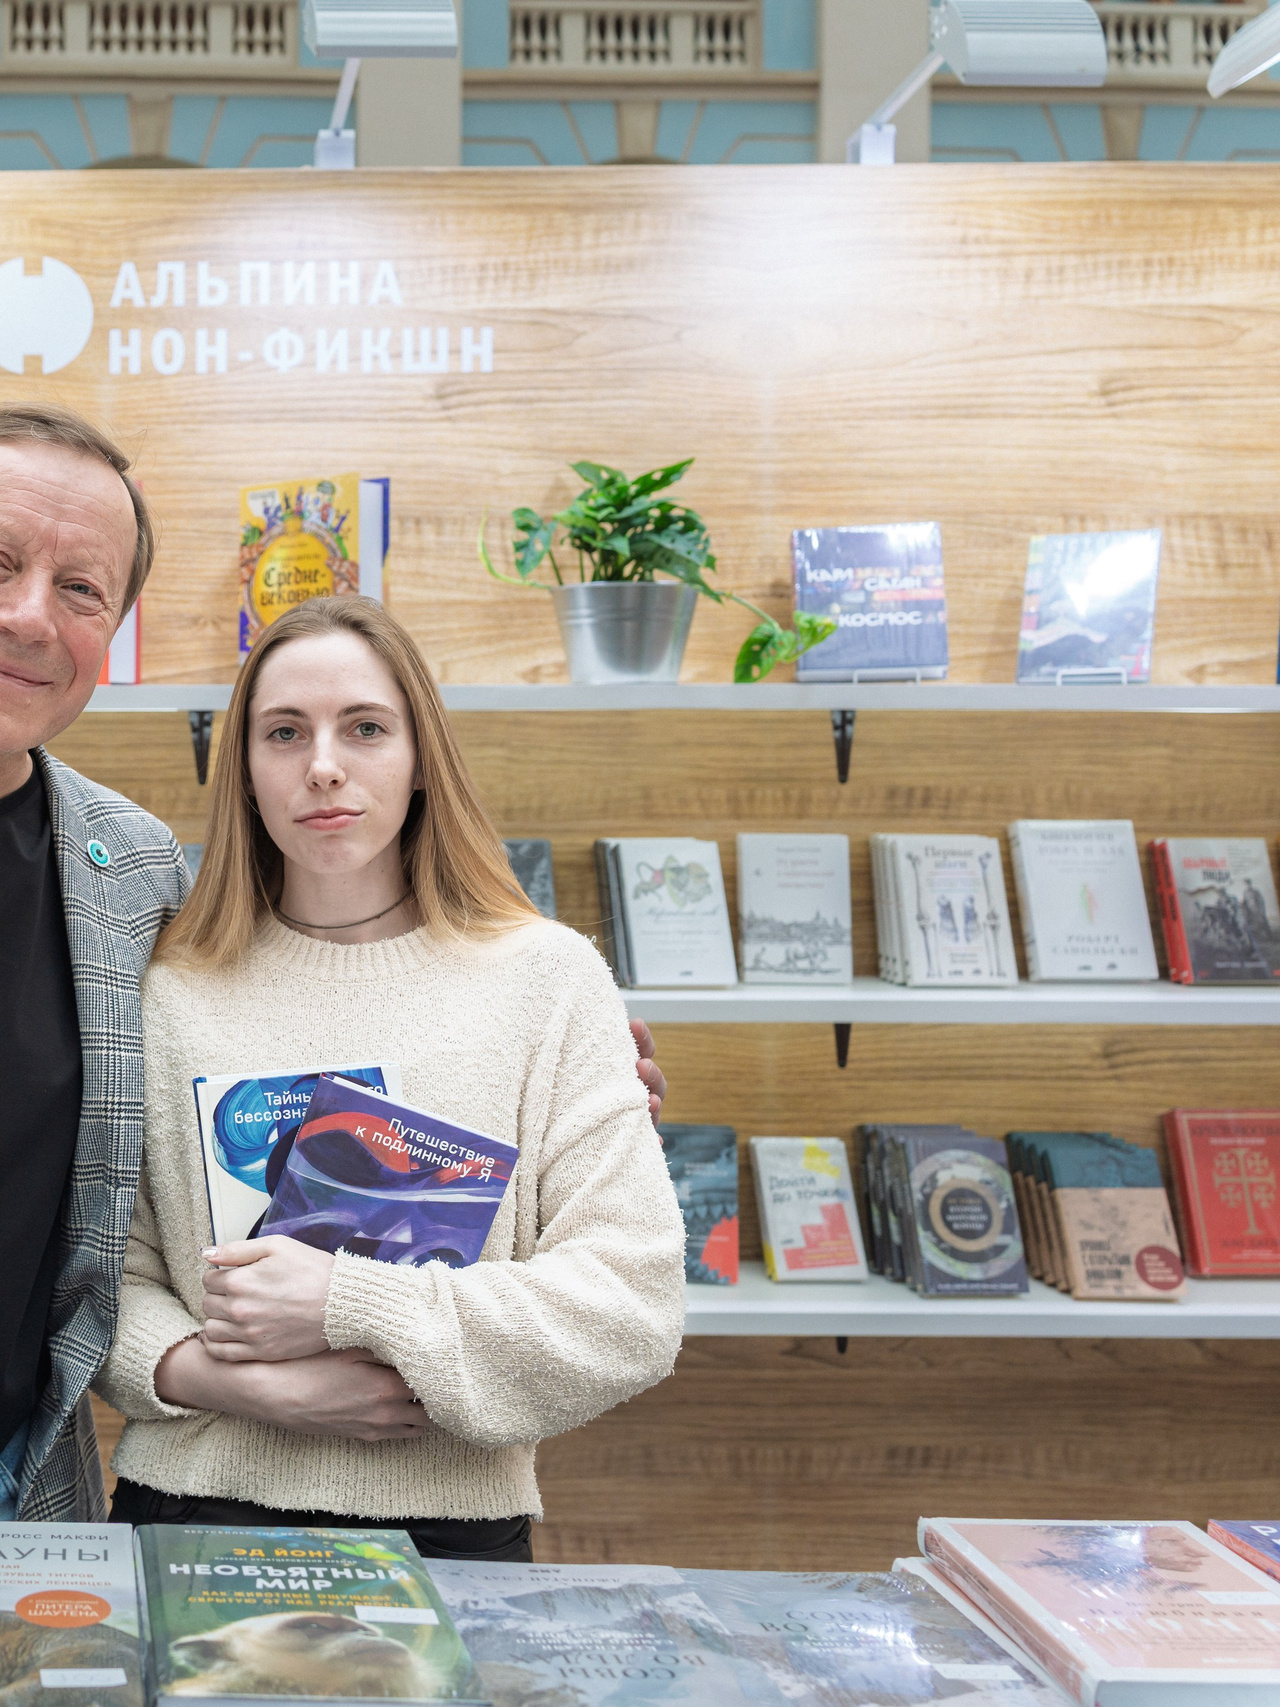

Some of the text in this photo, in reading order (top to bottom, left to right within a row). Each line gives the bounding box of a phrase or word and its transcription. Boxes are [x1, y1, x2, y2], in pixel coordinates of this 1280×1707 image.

[109, 260, 404, 308] АЛЬПИНА
[107, 326, 495, 375] НОН-ФИКШН
[838, 610, 923, 627] КОСМОС
[388, 1117, 496, 1168] Путешествие
[355, 1126, 492, 1183] к подлинному Я
[1, 1532, 43, 1540] РОСС
[232, 1547, 335, 1558] ЭД ЙОНГ
[169, 1563, 411, 1581] НЕОБЪЯТНЫЙ
[45, 1579, 112, 1587] ЛЕНИВЦЕВ
[255, 1578, 333, 1591] МИР
[188, 1596, 257, 1605] СКРЫТУЮ
[263, 1597, 280, 1605] ОТ
[234, 1591, 311, 1599] ЖИВОТНЫЕ
[317, 1593, 391, 1601] ОЩУЩАЮТ
[28, 1609, 100, 1618] ШАУТЕНА
[35, 1603, 94, 1611] ПИТЕРА
[554, 1666, 677, 1680] СОВЫ
